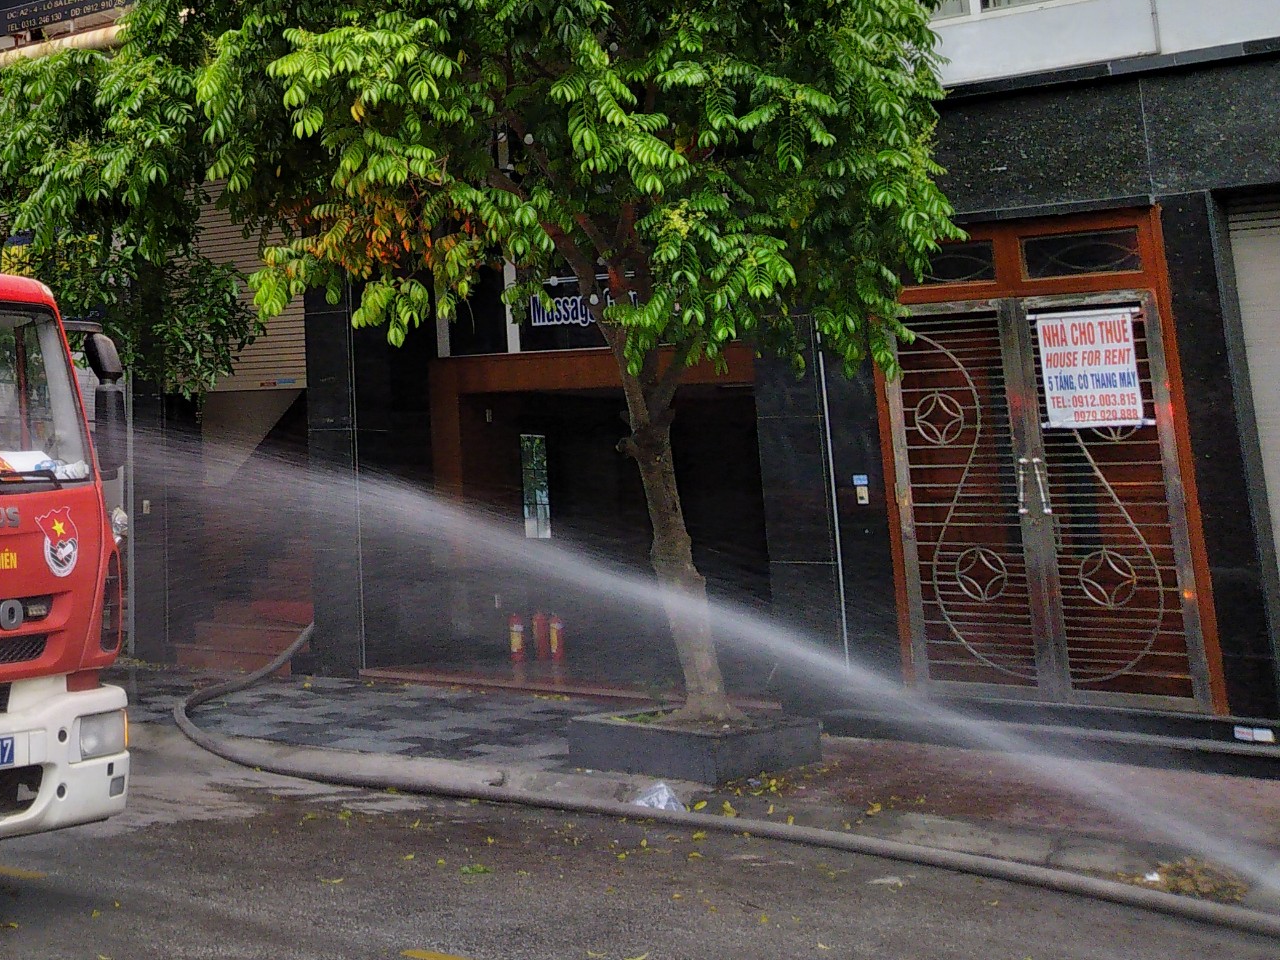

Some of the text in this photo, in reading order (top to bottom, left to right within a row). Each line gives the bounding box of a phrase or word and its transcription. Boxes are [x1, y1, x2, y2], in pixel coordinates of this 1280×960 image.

[1042, 314, 1130, 348] NHÀ CHO THUÊ
[1045, 348, 1132, 369] HOUSE FOR RENT
[1047, 376, 1053, 392] 5
[1090, 372, 1117, 389] THANG
[1119, 368, 1137, 388] MÁY
